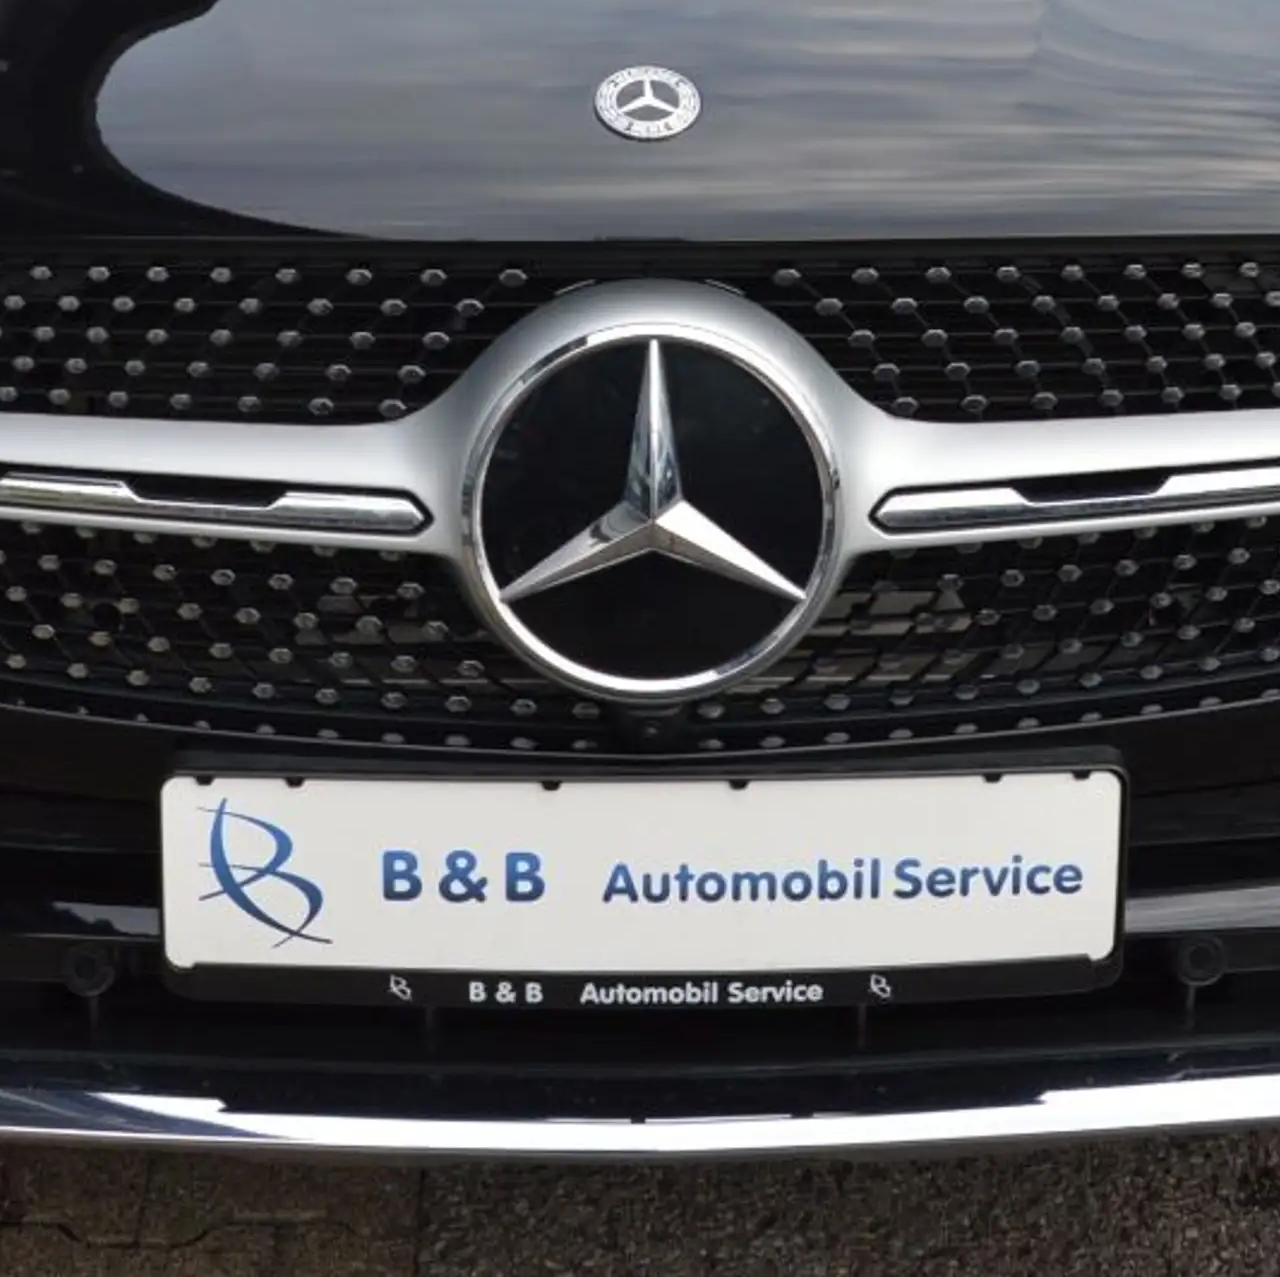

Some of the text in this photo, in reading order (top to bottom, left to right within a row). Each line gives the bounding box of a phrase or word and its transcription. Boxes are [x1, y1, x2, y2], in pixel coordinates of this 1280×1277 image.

[382, 849, 1084, 905] B & B Automobil Service
[469, 978, 824, 1004] B & B Automobil Service
